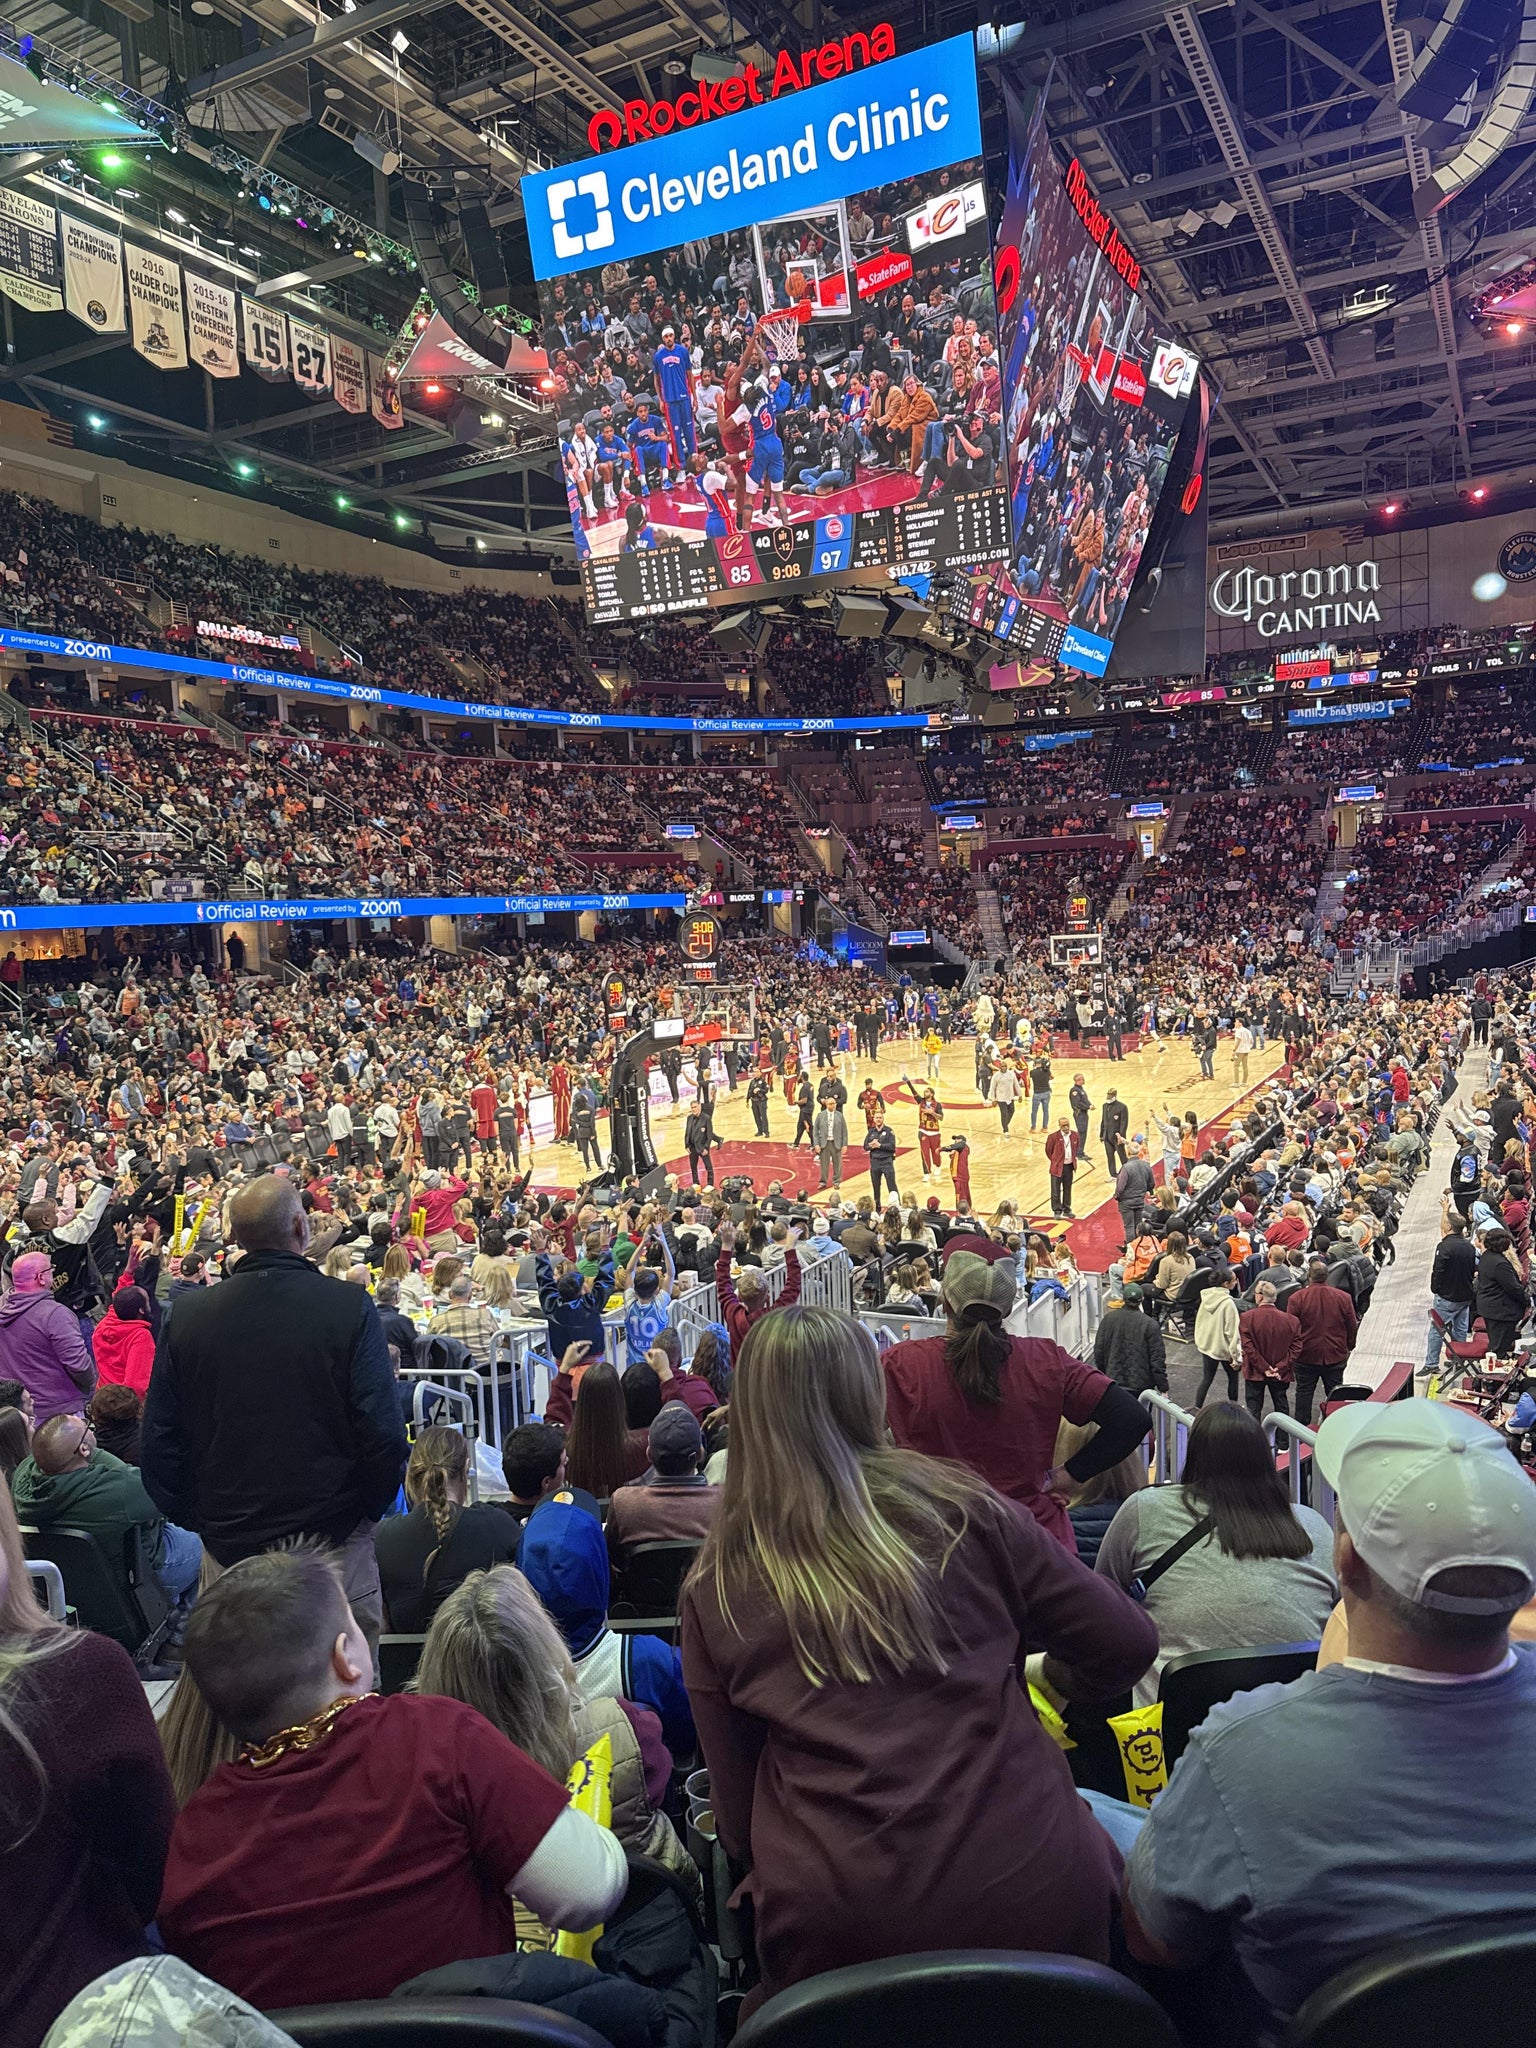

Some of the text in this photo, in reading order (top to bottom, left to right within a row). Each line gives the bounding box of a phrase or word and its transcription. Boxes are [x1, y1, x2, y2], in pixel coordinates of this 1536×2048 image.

[624, 22, 897, 144] Rocket Arena
[620, 88, 951, 224] Cleveland Clinic
[69, 226, 88, 241] NORTH
[1073, 169, 1142, 290] Rocket Arena
[68, 235, 118, 264] CHAMPIONS
[141, 258, 165, 277] 2016
[5, 278, 52, 301] CALDER CUP
[130, 268, 179, 298] CALDER CUP
[193, 282, 228, 307] 2015-16
[132, 284, 179, 313] CHAMPIONS
[195, 299, 229, 322] WESTERN
[191, 310, 235, 337] CONFERENCE
[193, 324, 234, 349] CHAMPIONS
[252, 322, 281, 366] 15
[296, 341, 326, 385] 27
[981, 489, 992, 497] AST
[862, 510, 880, 519] FOULS
[956, 504, 965, 513] 27
[973, 511, 981, 519] 10
[755, 529, 810, 548] 4Q 24
[778, 542, 791, 551] -12
[730, 550, 842, 584] 85 9:08 97
[888, 547, 1009, 580] $10,742 CAVS5050.COM
[1208, 564, 1382, 622] Corona
[594, 606, 620, 620] oswald
[667, 597, 709, 611] RAFFLE
[1257, 600, 1381, 637] CANTINA
[198, 620, 230, 636] BALL
[10, 634, 112, 660] presented by zoom
[239, 667, 275, 684] Official
[277, 671, 312, 690] Review
[314, 682, 340, 692] presented
[350, 685, 382, 700] zoom
[1200, 690, 1213, 700] 85
[1231, 687, 1242, 696] 24
[1257, 684, 1275, 693] 9:08
[1290, 680, 1305, 690] 4Q
[1320, 677, 1334, 687] 97
[1406, 668, 1419, 678] 43
[1432, 663, 1460, 674] FOULS
[1485, 657, 1504, 667] TOL
[1509, 654, 1517, 665] 3
[470, 705, 502, 718] Official
[503, 708, 535, 720] Review
[569, 713, 602, 726] zoom
[1044, 708, 1060, 716] TOL
[698, 720, 730, 730] Official
[731, 720, 764, 730] Review
[801, 719, 834, 729] zoom
[206, 900, 402, 920] Official Review presented by zoom
[510, 898, 541, 911] Official
[542, 898, 572, 910] Review
[603, 896, 629, 908] zoom
[708, 895, 717, 903] 11
[729, 894, 755, 902] BLOCKS
[692, 921, 714, 933] 9:08
[688, 933, 712, 955] 24
[639, 1101, 655, 1163] Cleveland Clinic
[629, 1315, 659, 1338] 10
